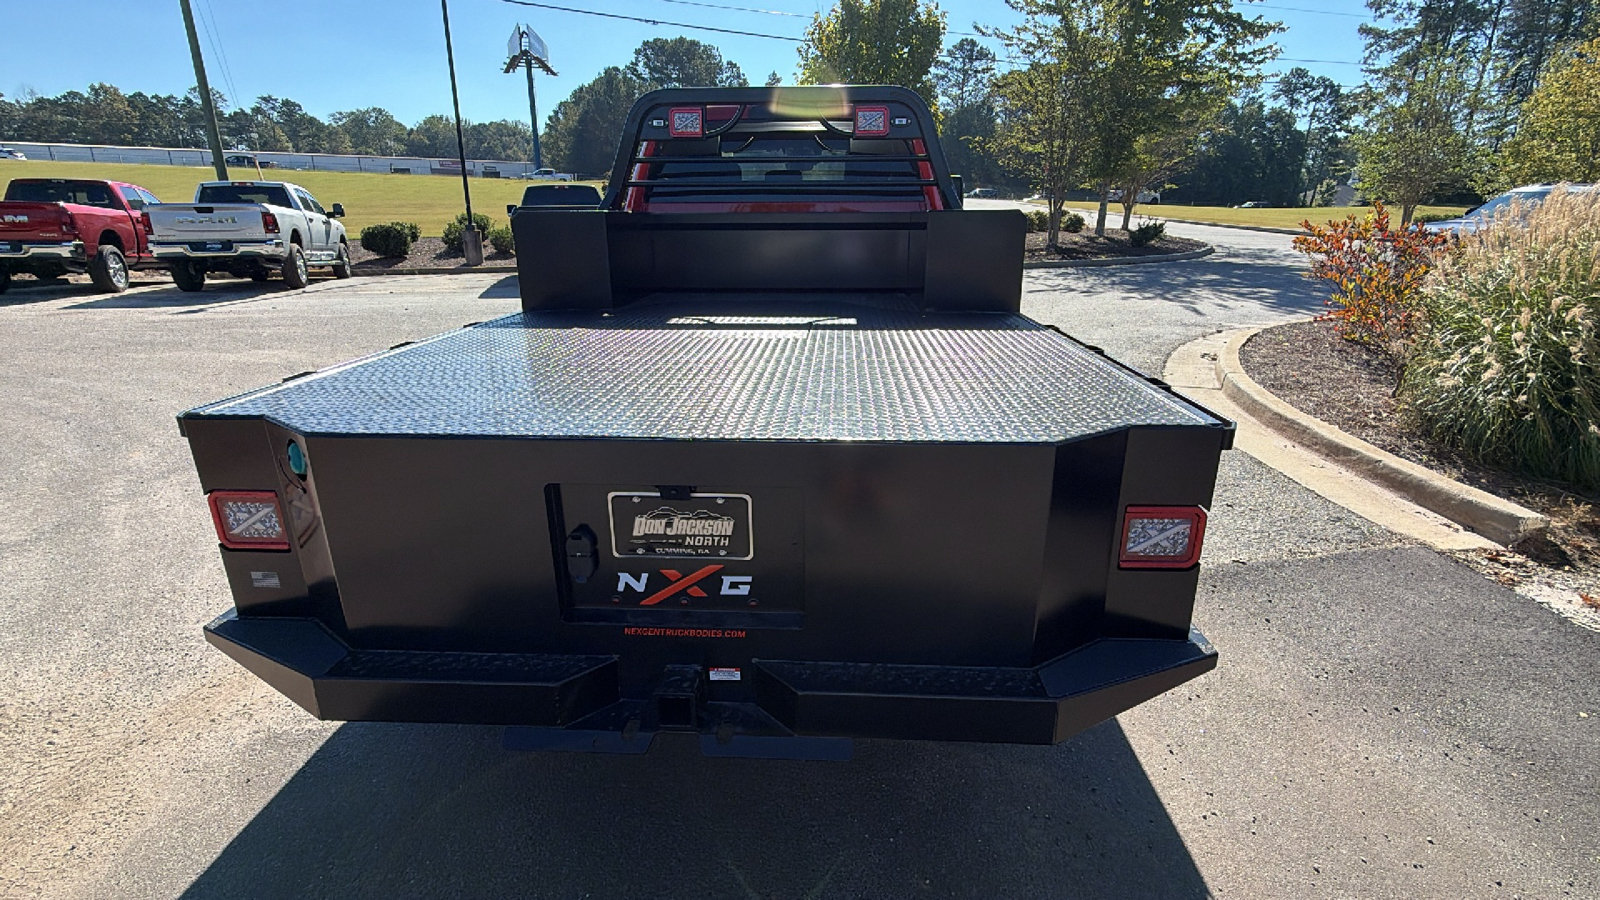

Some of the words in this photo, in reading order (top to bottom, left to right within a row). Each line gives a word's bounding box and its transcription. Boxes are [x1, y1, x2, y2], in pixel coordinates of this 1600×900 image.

[632, 515, 666, 537] DON
[665, 516, 735, 536] JACKSON
[684, 536, 730, 547] NORTH
